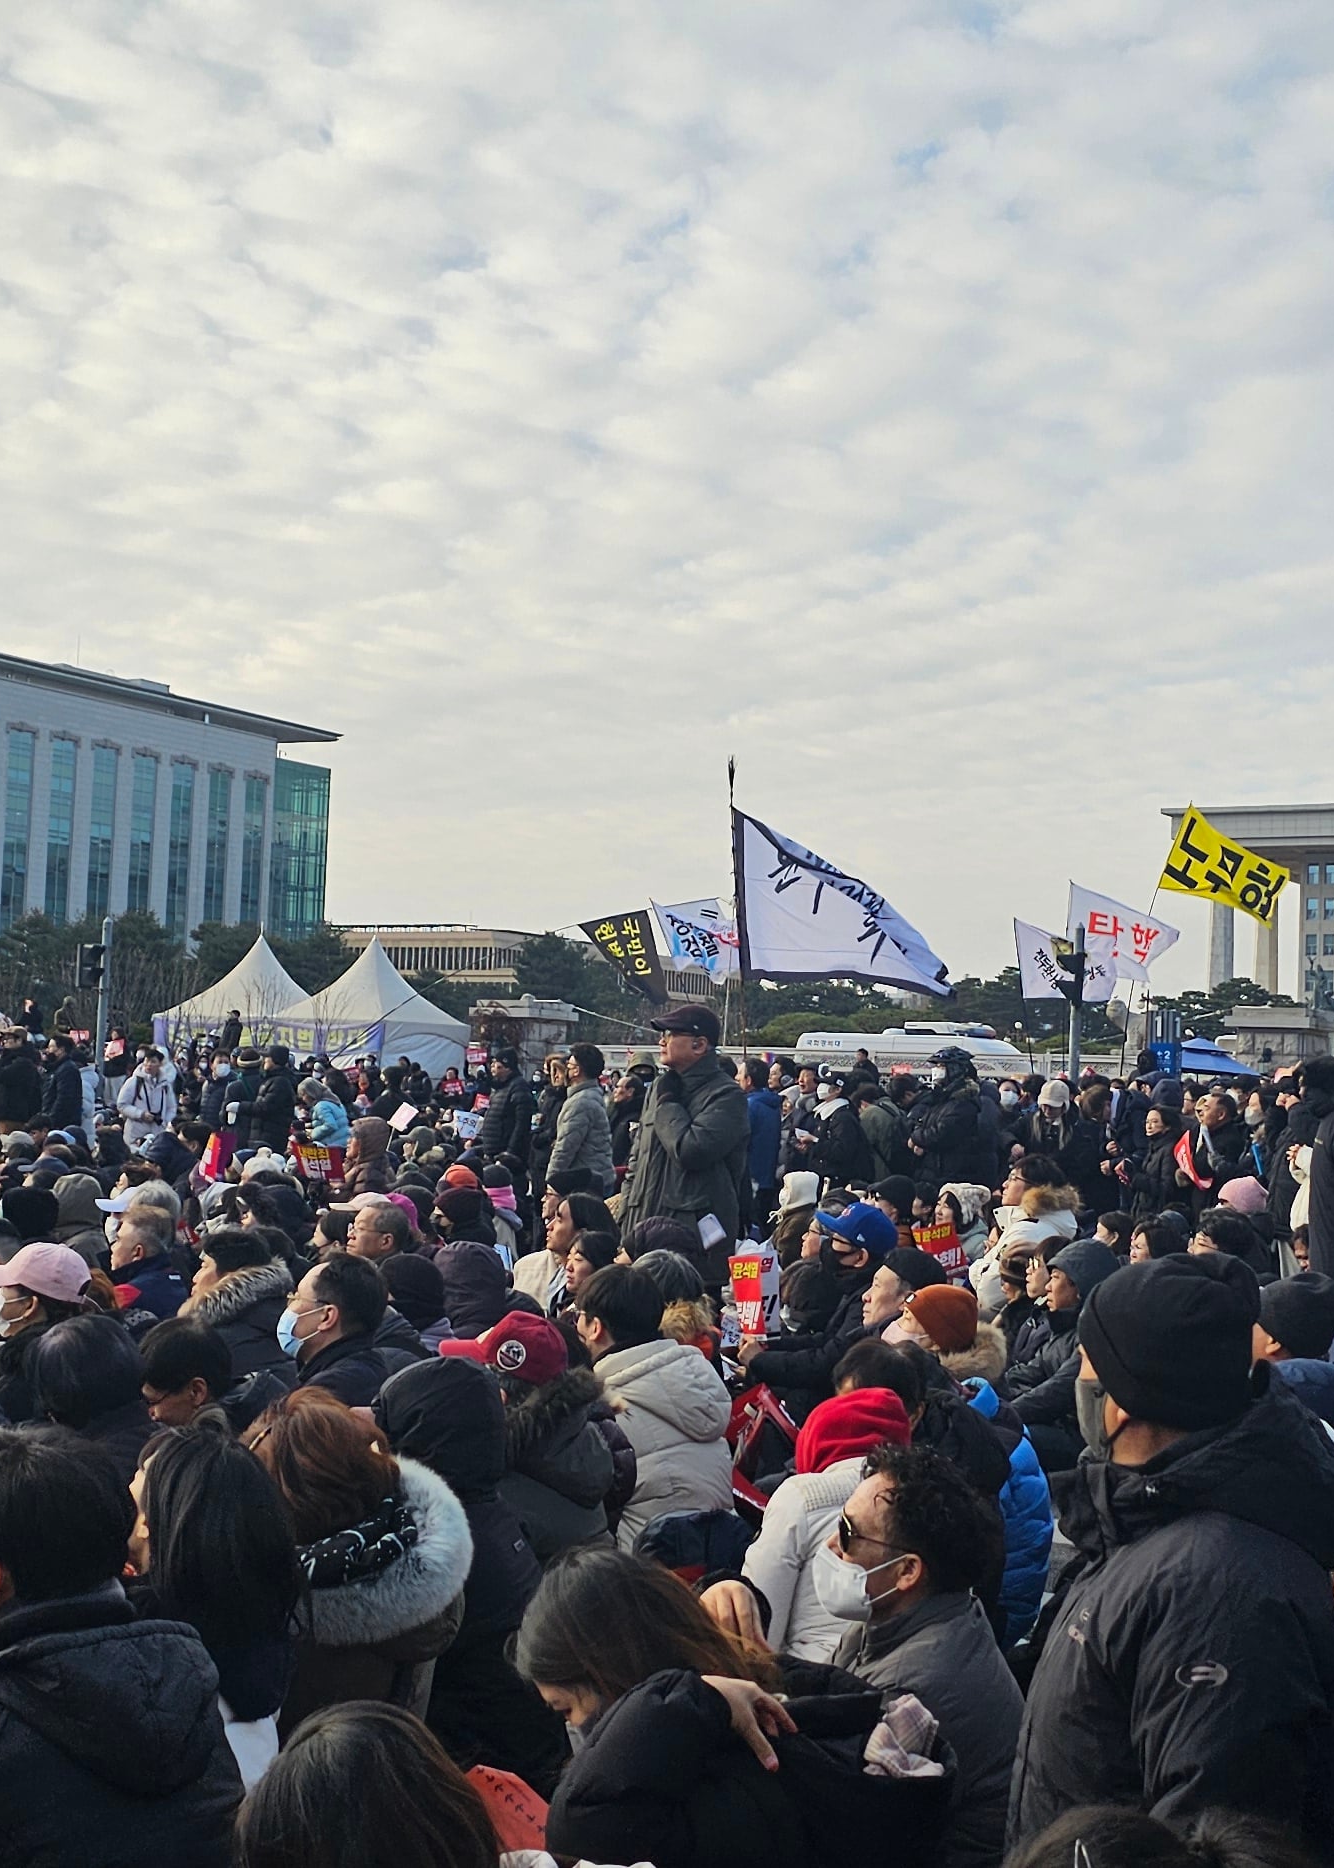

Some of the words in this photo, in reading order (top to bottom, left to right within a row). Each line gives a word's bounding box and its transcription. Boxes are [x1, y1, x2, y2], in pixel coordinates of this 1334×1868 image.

[1164, 816, 1285, 921] 노무현
[621, 917, 652, 976] 국민이
[1087, 911, 1161, 964] 탄핵
[1154, 1015, 1163, 1038] 1
[1164, 1050, 1171, 1060] 2
[922, 1225, 951, 1243] 윤석열
[732, 1261, 759, 1280] 윤석열
[736, 1300, 762, 1331] 탄핵!
